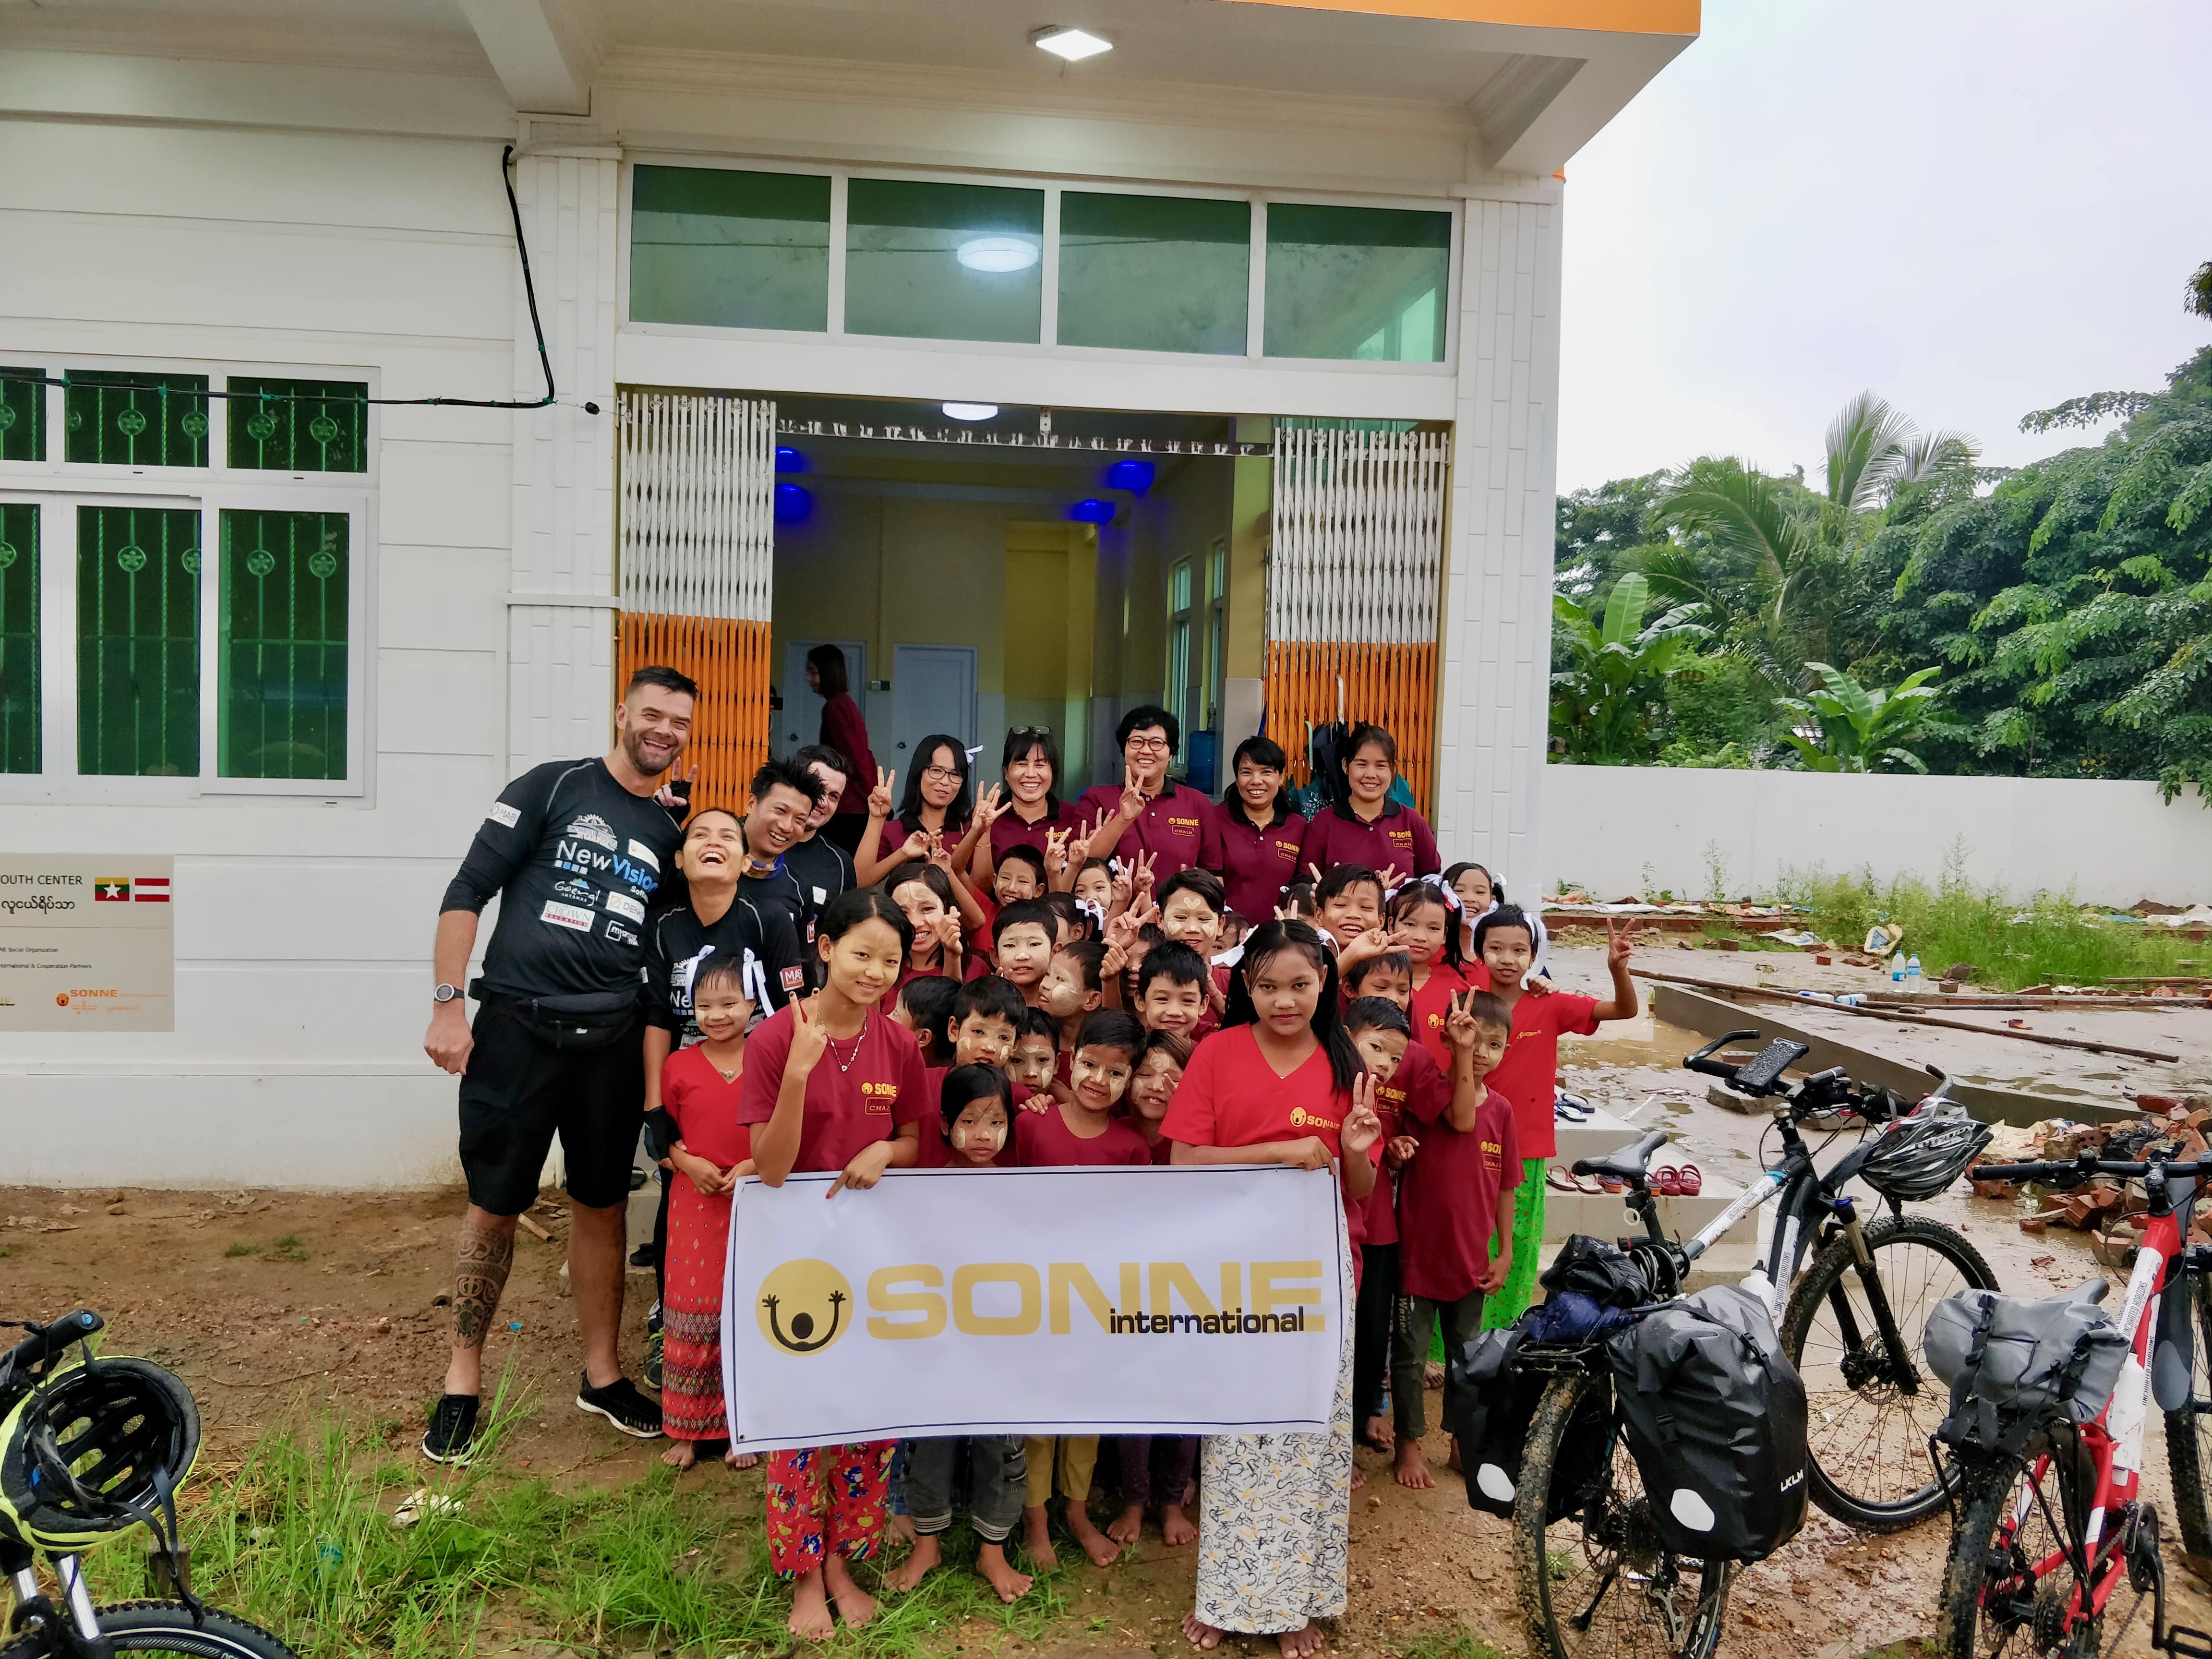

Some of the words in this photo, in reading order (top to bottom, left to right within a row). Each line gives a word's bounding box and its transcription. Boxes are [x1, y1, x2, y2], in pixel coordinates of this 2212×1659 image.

[1176, 817, 1199, 826] SONNE
[1283, 842, 1300, 854] SONN
[0, 875, 33, 884] OUTH
[37, 875, 83, 885] CENTER
[785, 969, 802, 982] MAB
[875, 1083, 897, 1097] SONE
[866, 1260, 1325, 1339] SONNE
[2122, 1306, 2138, 1337] UNCHARTED
[2133, 1280, 2148, 1308] HORIZONS
[1110, 1306, 1304, 1334] international
